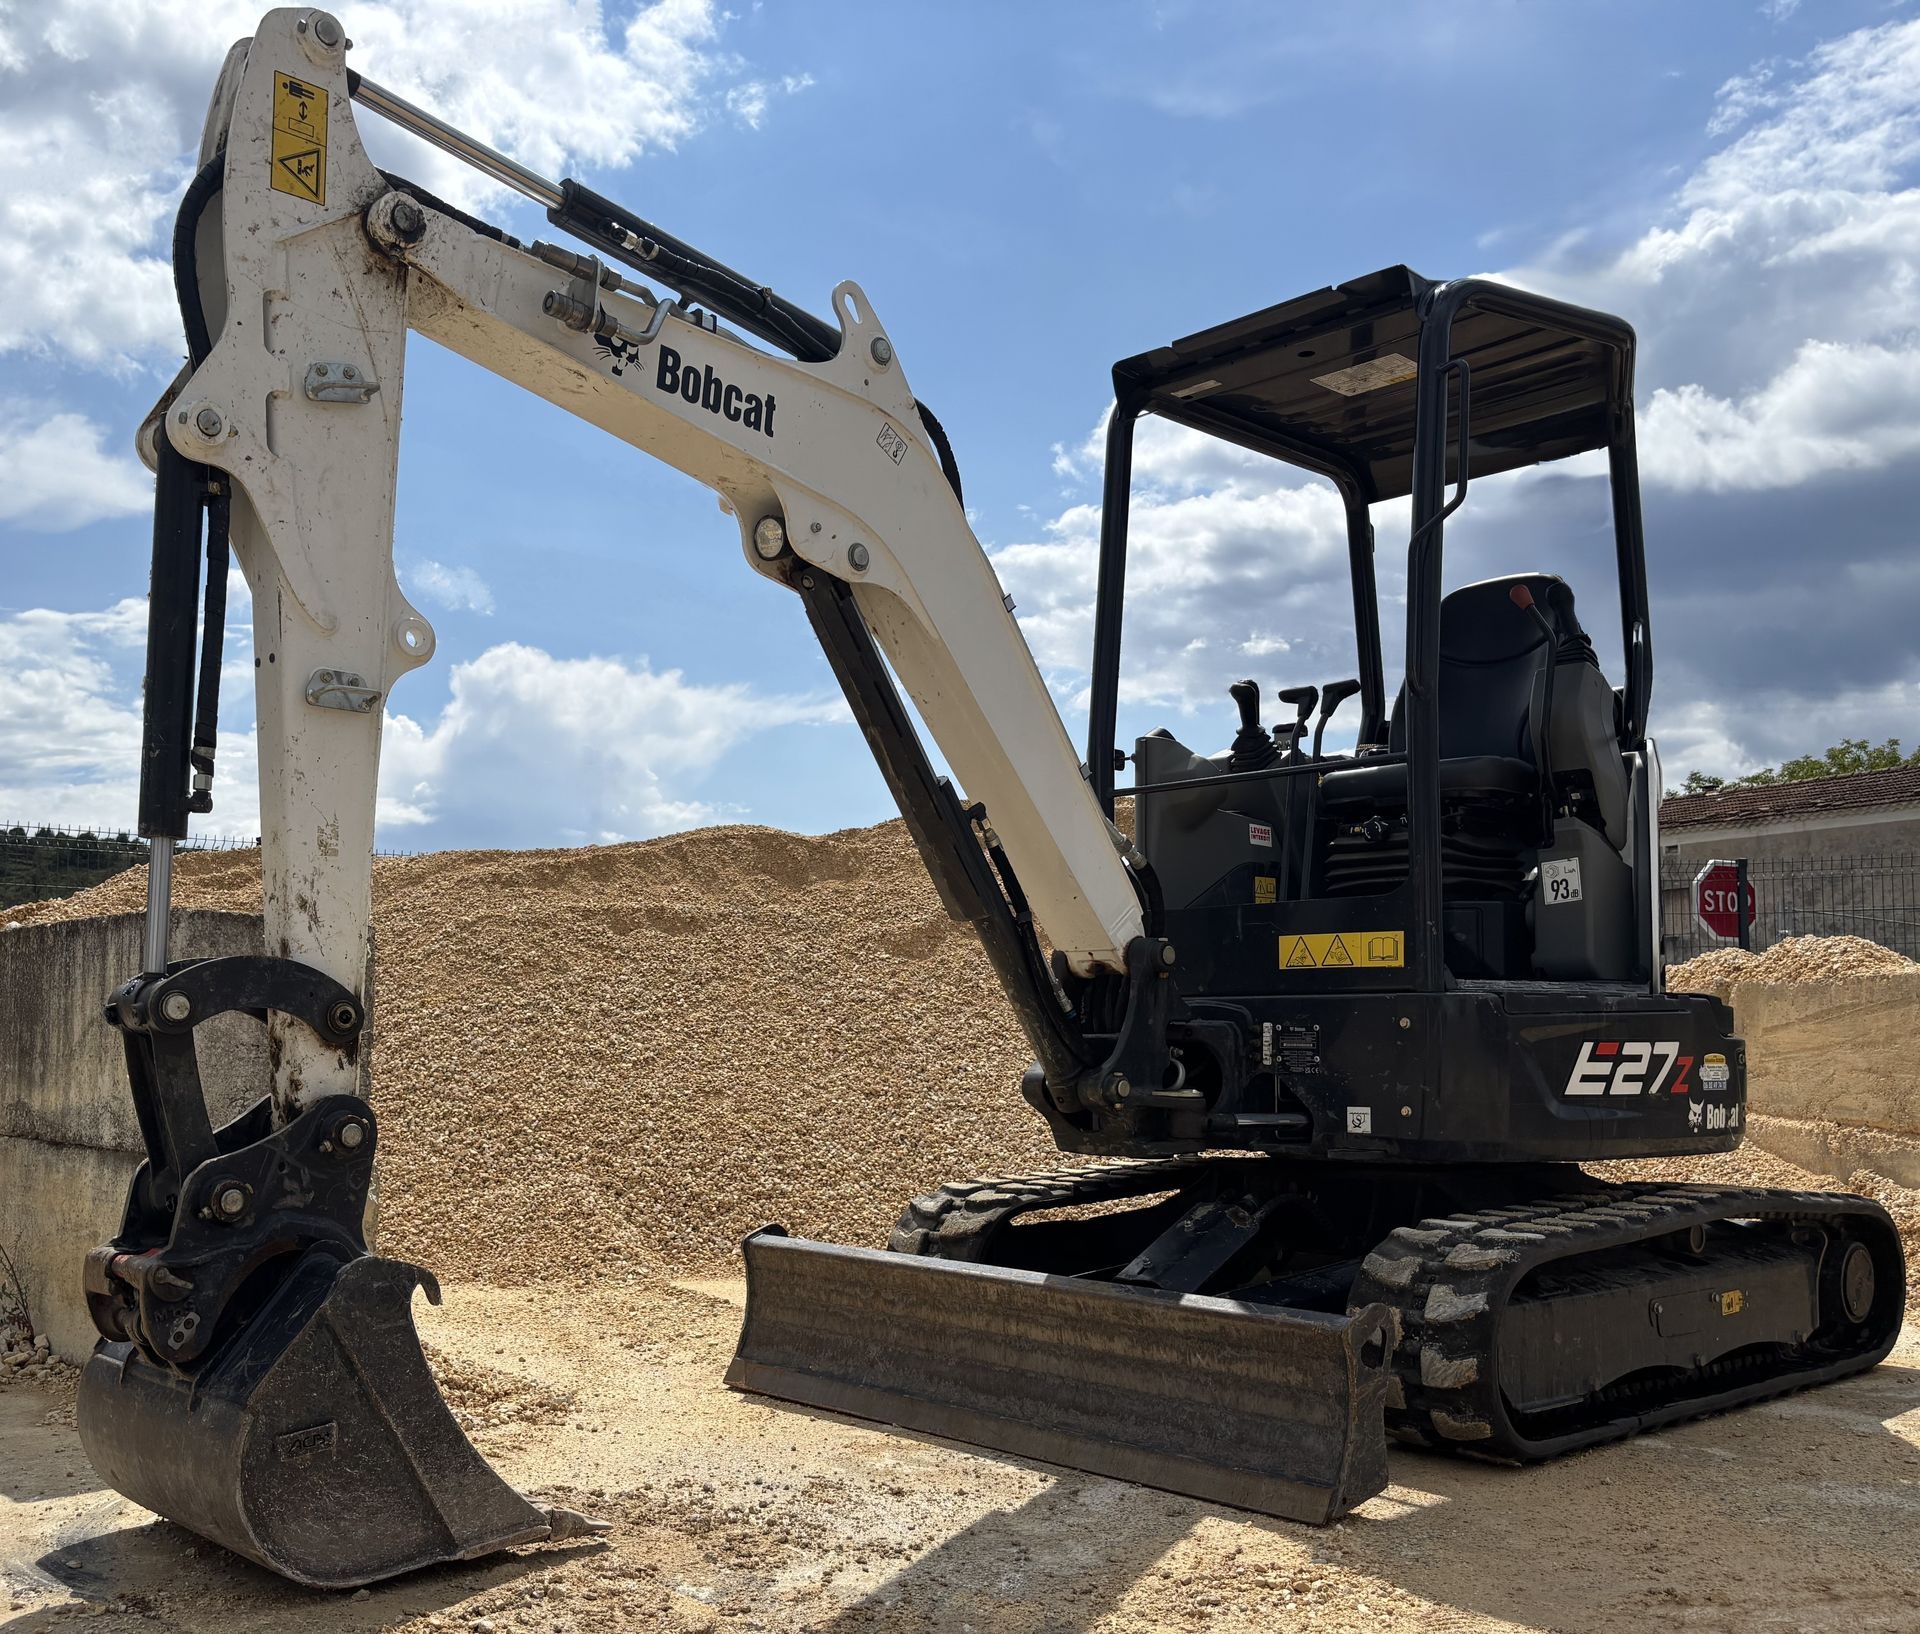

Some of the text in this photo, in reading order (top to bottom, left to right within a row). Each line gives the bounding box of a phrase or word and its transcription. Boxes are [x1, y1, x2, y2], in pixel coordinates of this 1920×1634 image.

[656, 344, 776, 438] Bobcat
[1551, 878, 1579, 901] 93 dB
[1704, 889, 1752, 912] STO
[1706, 1103, 1739, 1130] Bobat
